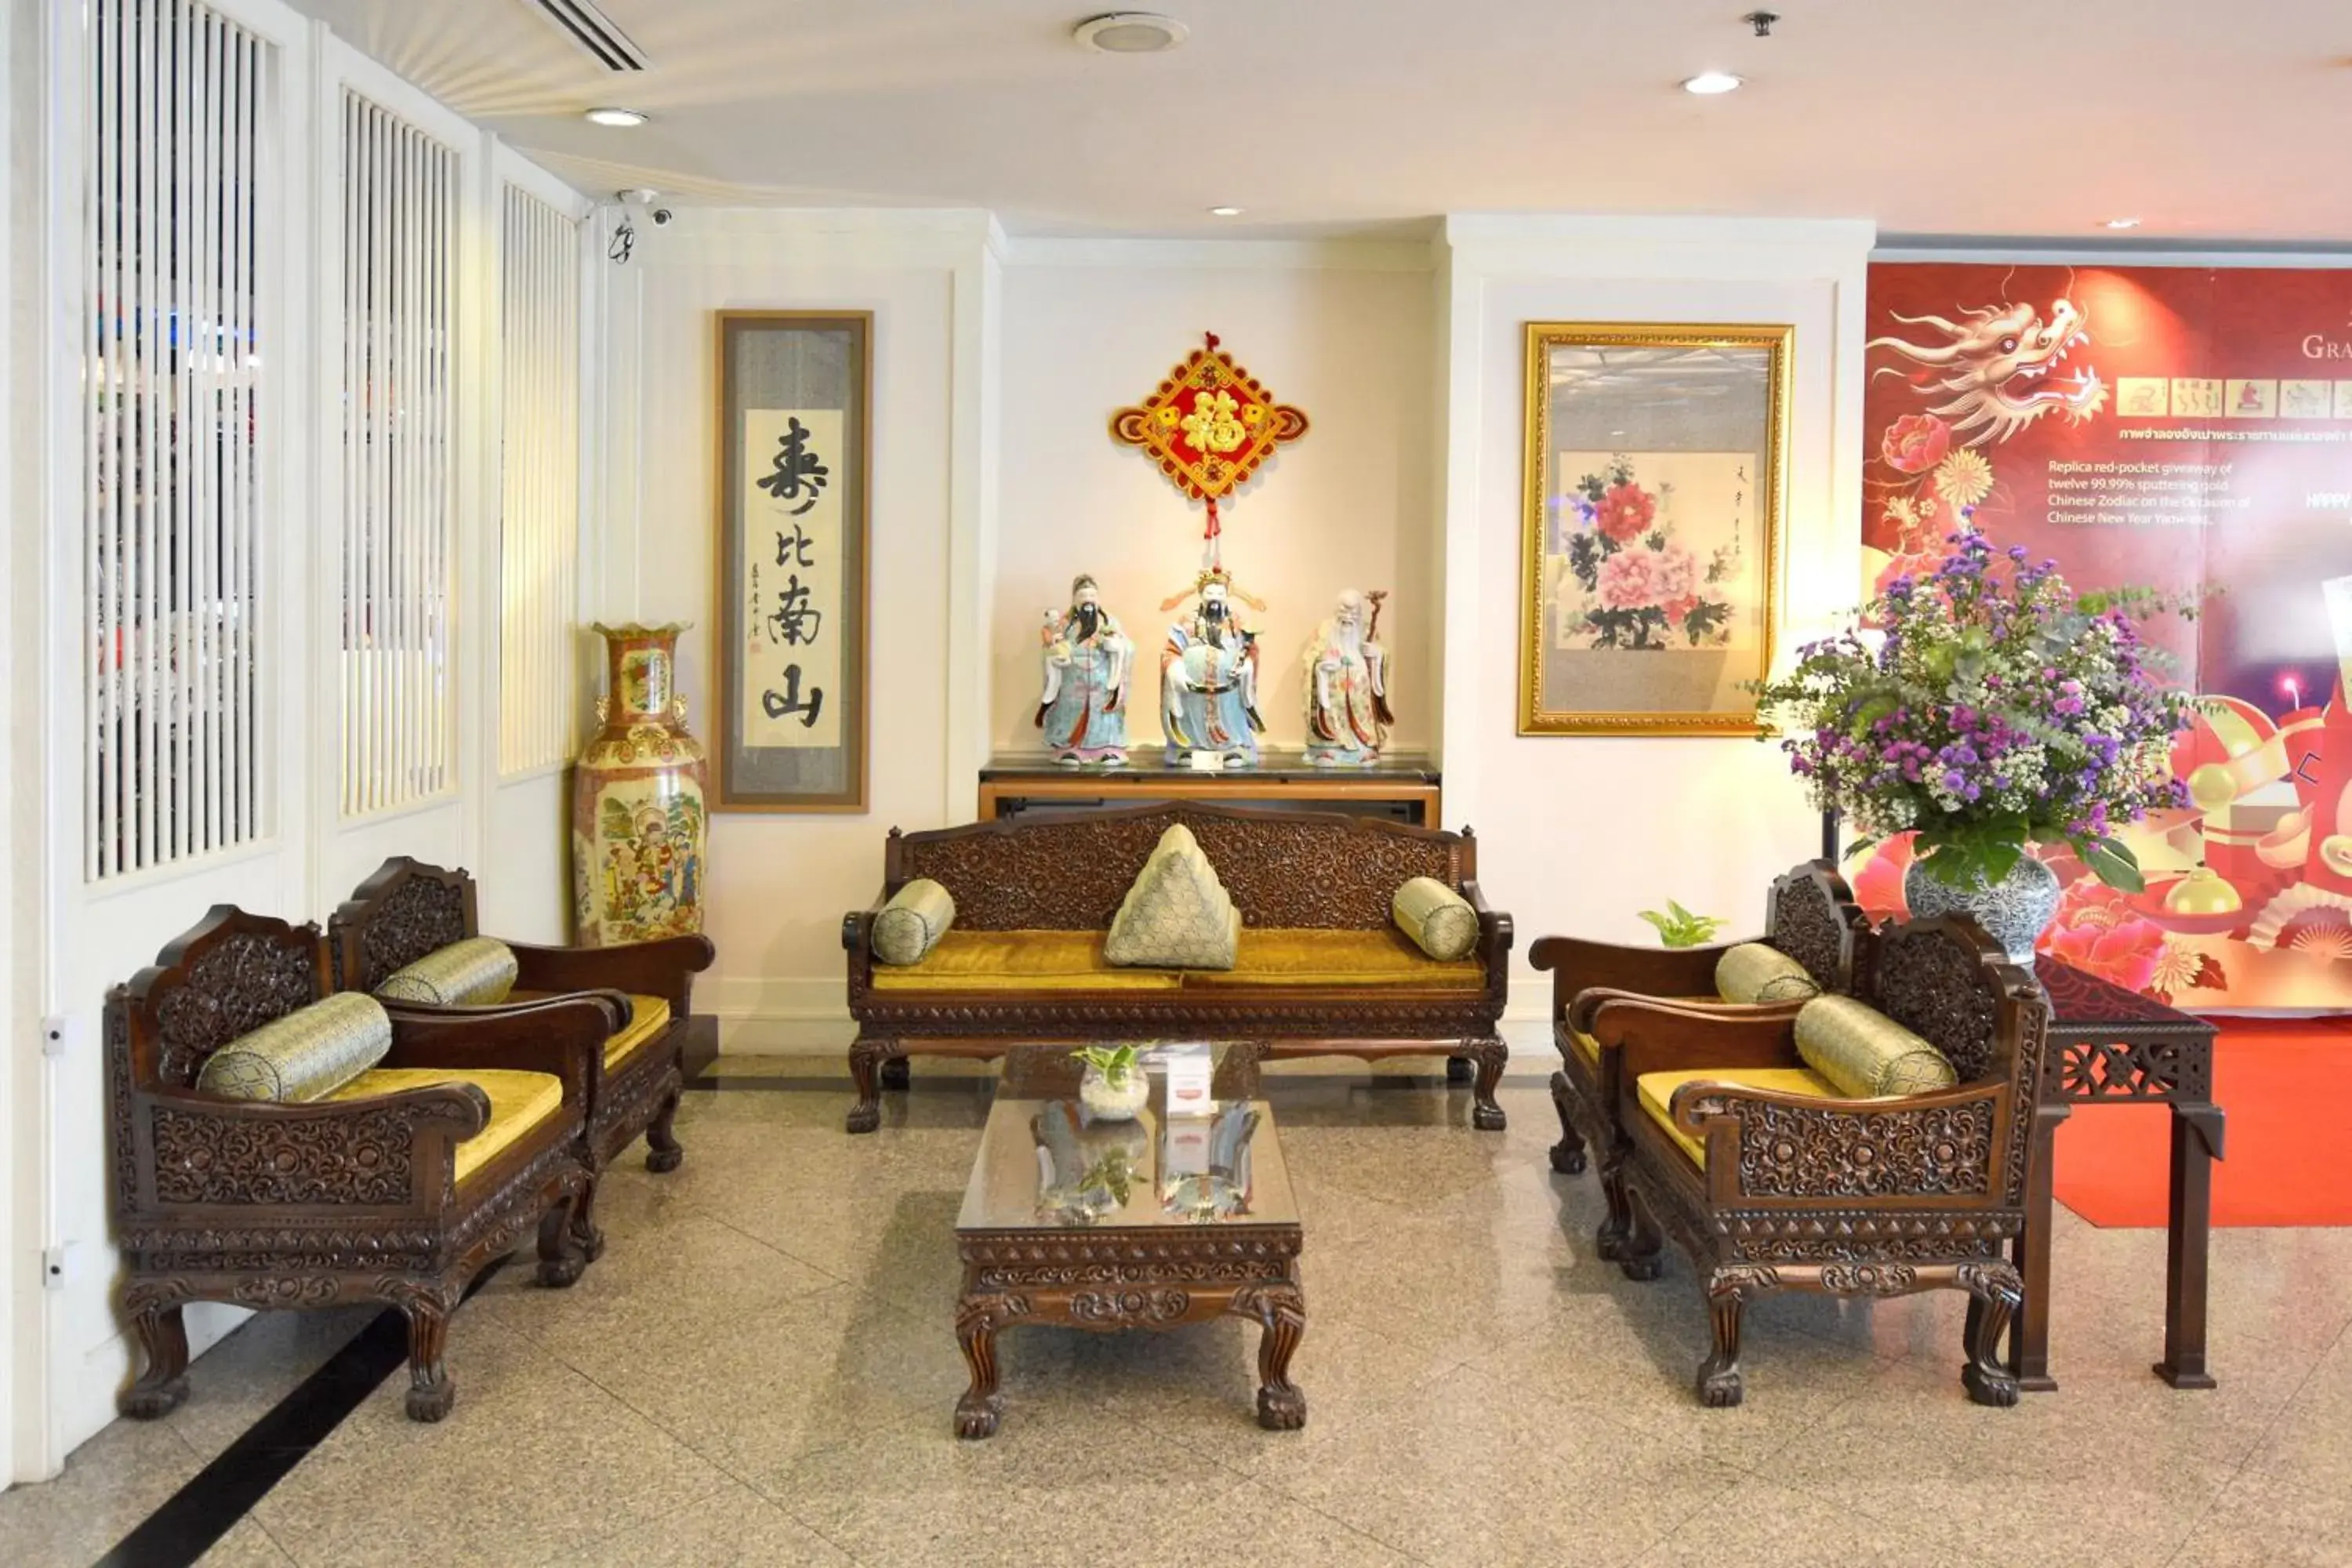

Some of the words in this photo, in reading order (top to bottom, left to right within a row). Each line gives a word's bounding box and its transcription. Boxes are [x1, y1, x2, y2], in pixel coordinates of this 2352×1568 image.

[1181, 390, 1246, 452] 福
[2049, 460, 2092, 474] Replica
[2095, 460, 2159, 474] red-pocket
[2220, 463, 2233, 474] of
[2049, 477, 2089, 489] twelve
[2091, 477, 2135, 490] 99.99%
[2047, 494, 2096, 507] Chinese
[2098, 494, 2139, 507] Zodiac
[2140, 497, 2157, 507] on
[2306, 492, 2351, 509] HAPPY
[2047, 510, 2096, 524] Chinese
[2097, 511, 2125, 524] New
[2127, 511, 2152, 524] Year
